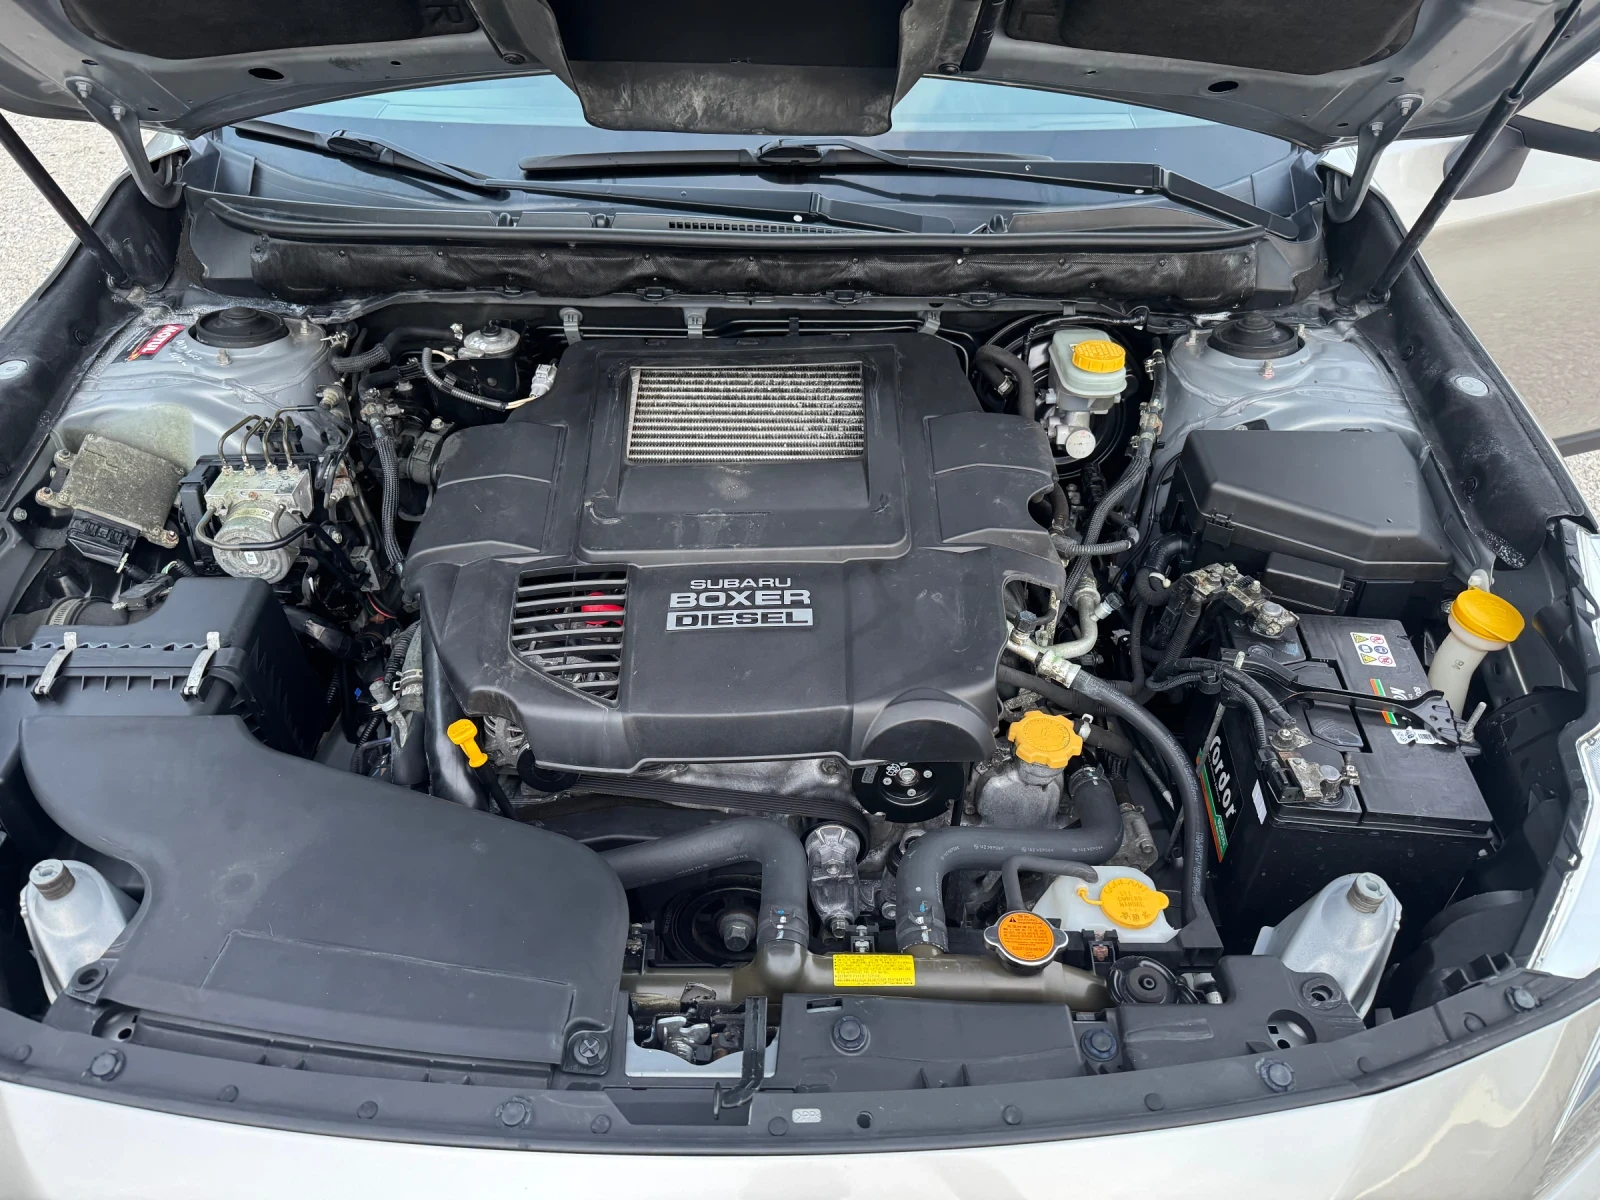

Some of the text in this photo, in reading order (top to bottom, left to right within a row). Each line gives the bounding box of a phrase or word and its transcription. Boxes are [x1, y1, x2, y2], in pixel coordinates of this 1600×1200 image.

[141, 325, 180, 353] MOTUL
[690, 577, 791, 590] SUBARU
[669, 589, 811, 608] BOXER
[675, 611, 809, 628] DIESEL
